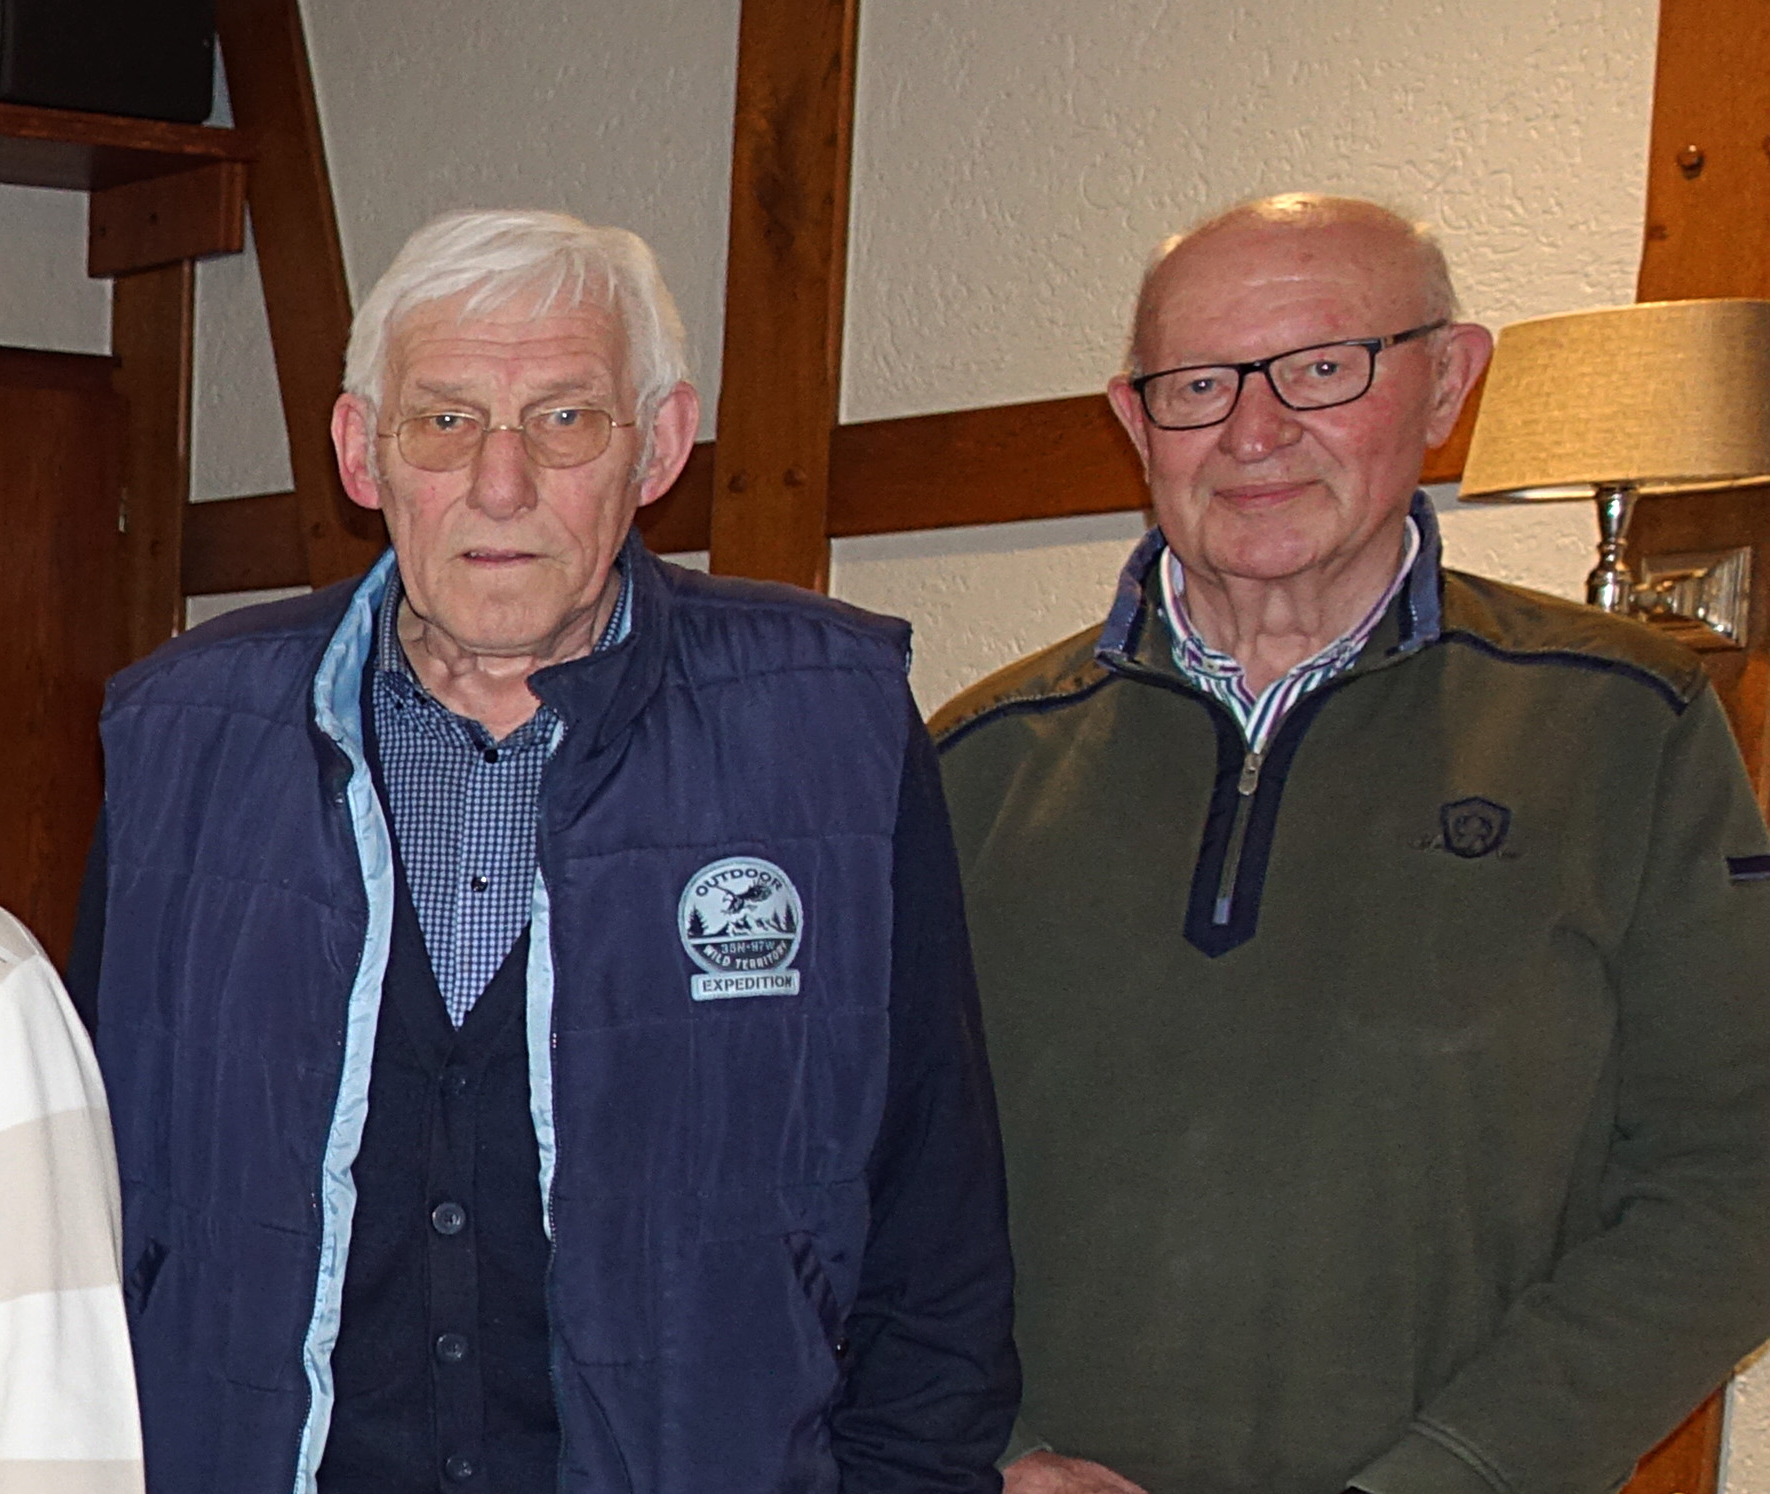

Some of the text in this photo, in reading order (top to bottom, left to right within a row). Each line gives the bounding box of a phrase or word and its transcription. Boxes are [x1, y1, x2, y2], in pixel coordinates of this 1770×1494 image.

[696, 868, 784, 897] OUTDOOR
[703, 944, 731, 967] WILD
[702, 976, 793, 993] EXPEDITION
